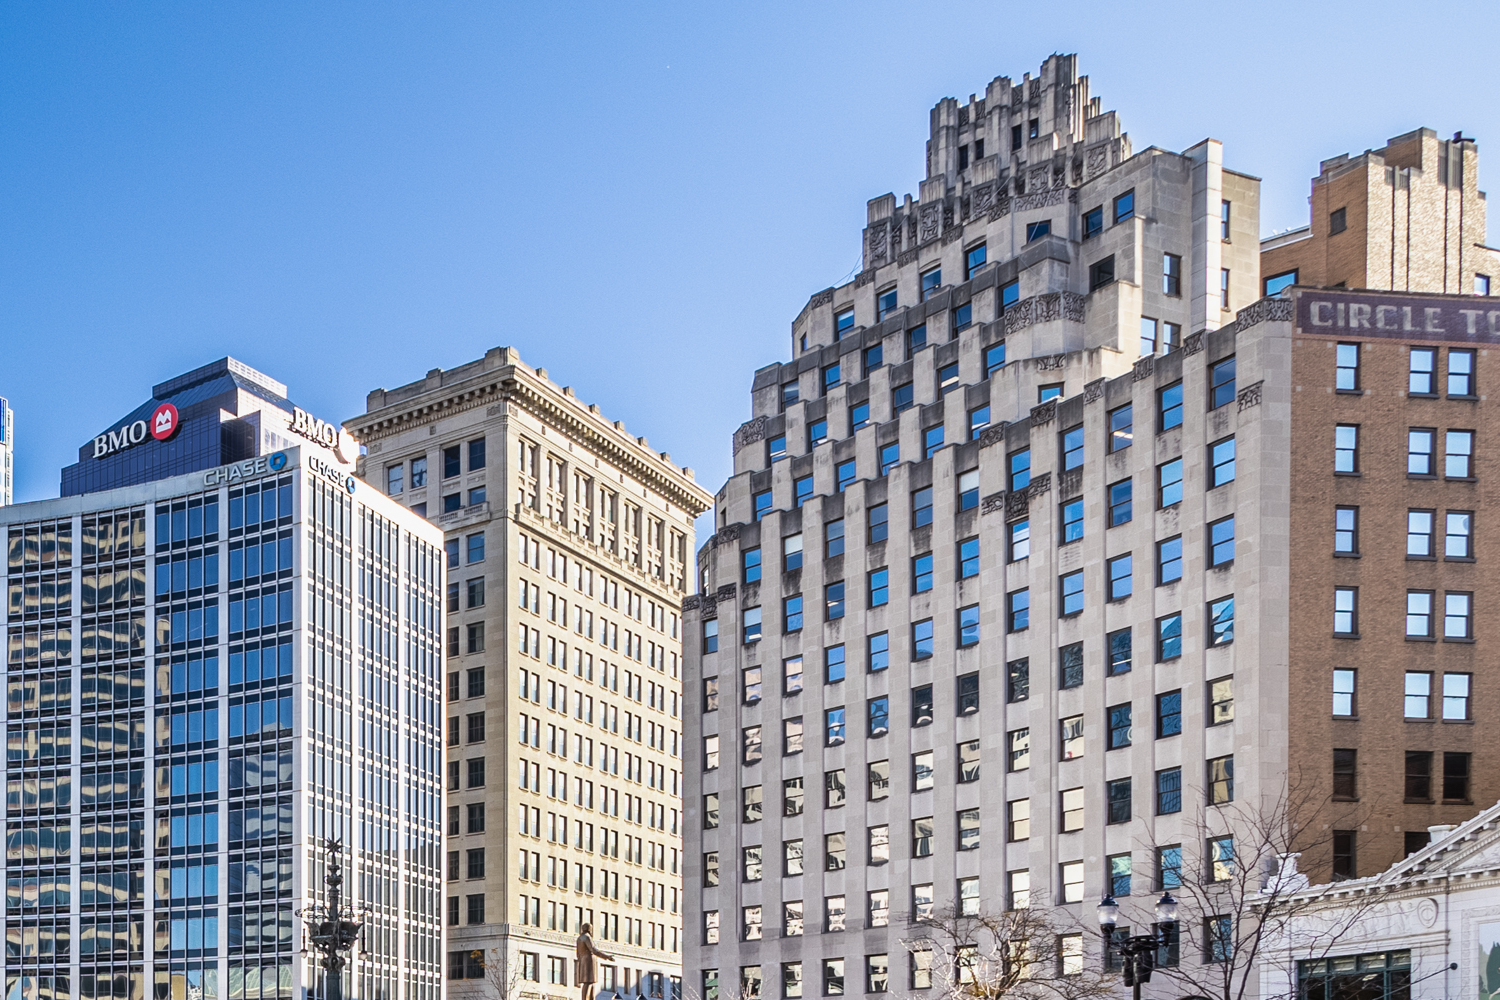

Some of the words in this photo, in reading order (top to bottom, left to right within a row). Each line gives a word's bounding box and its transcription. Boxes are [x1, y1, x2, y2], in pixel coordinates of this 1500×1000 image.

[1310, 300, 1445, 333] CIRCLE
[93, 420, 146, 458] BMO
[293, 406, 338, 448] BMO
[204, 457, 267, 486] CHASE
[309, 456, 345, 488] CHASE
